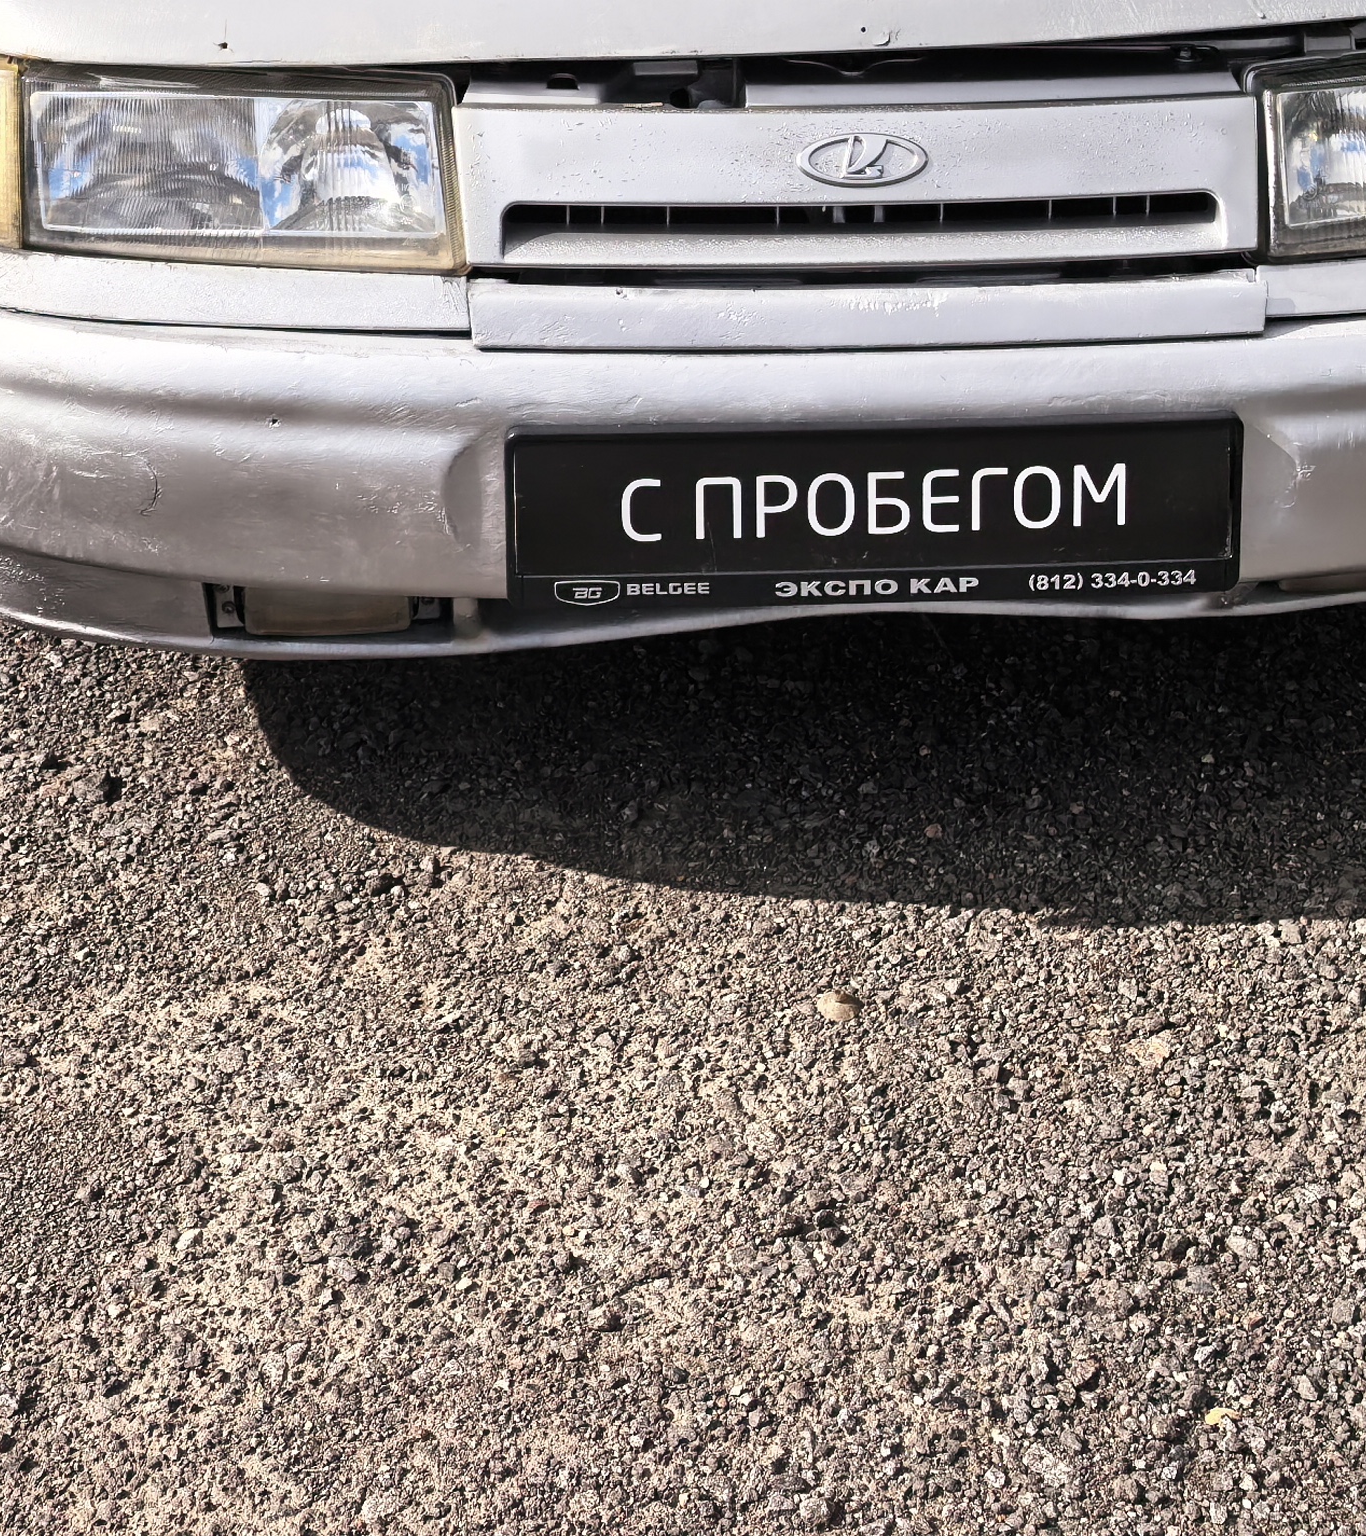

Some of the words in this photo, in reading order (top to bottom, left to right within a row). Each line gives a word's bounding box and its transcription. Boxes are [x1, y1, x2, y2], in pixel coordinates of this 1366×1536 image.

[621, 479, 662, 542] С
[696, 463, 1126, 539] ПРОБЕГОМ
[626, 581, 711, 596] BELGEE
[774, 579, 898, 598] ЭКСПО
[909, 576, 980, 594] КАР
[1028, 573, 1084, 592] (812)
[1090, 569, 1197, 589] 334-0-334
